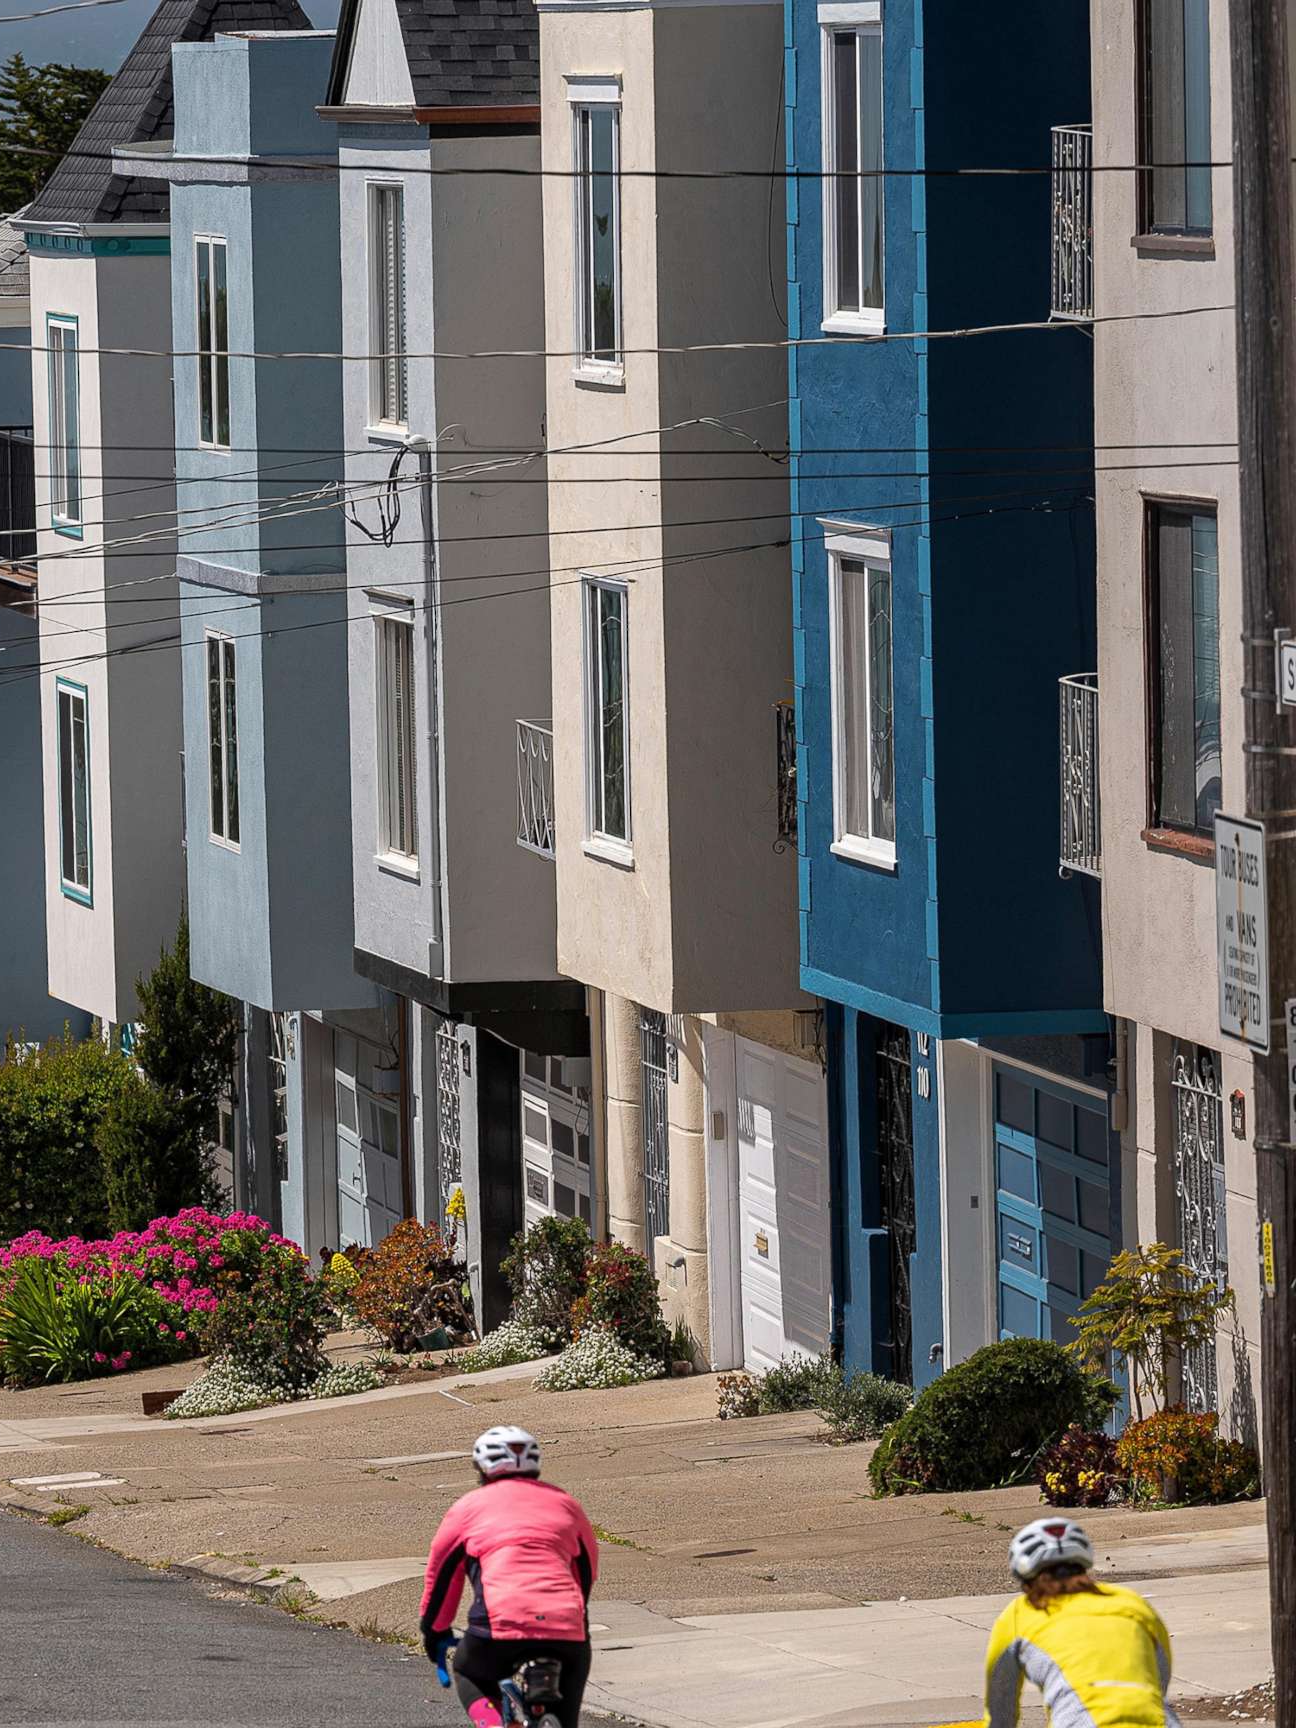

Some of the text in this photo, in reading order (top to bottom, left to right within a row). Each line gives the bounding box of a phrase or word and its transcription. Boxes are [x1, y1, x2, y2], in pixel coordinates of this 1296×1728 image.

[1220, 844, 1258, 887] TOUR BUSES
[1237, 910, 1257, 948] VANS
[1224, 982, 1261, 1026] PROHIBITED
[916, 1064, 930, 1099] 110
